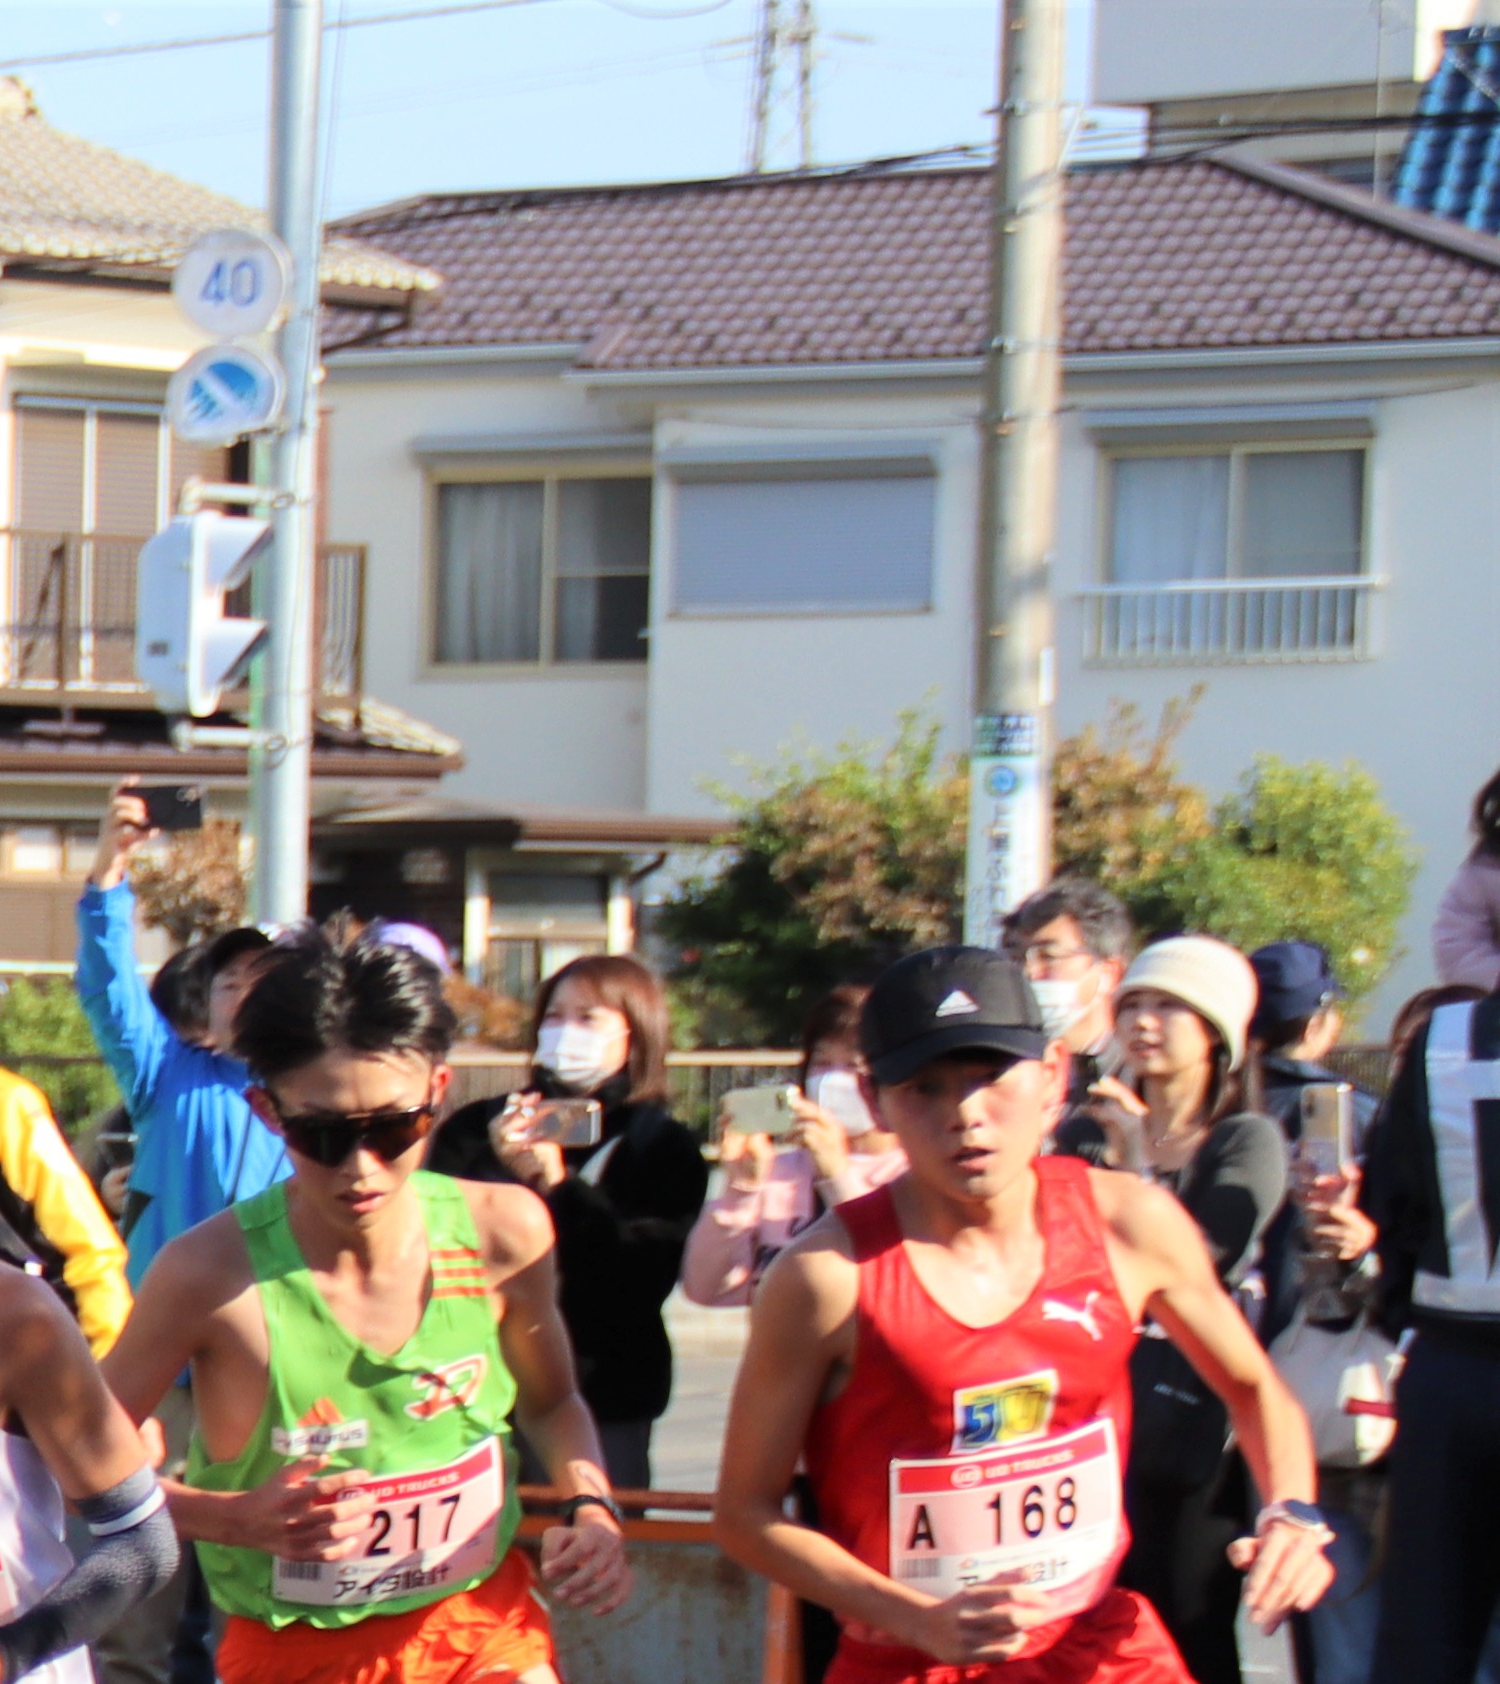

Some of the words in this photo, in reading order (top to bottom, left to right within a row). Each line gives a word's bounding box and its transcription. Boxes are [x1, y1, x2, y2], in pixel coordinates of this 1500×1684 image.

[200, 259, 262, 308] 40
[395, 1470, 460, 1494] TRUCKS
[1011, 1448, 1076, 1474] TRUCKS
[364, 1493, 462, 1558] 217
[905, 1503, 937, 1550] A
[986, 1476, 1078, 1545] 168
